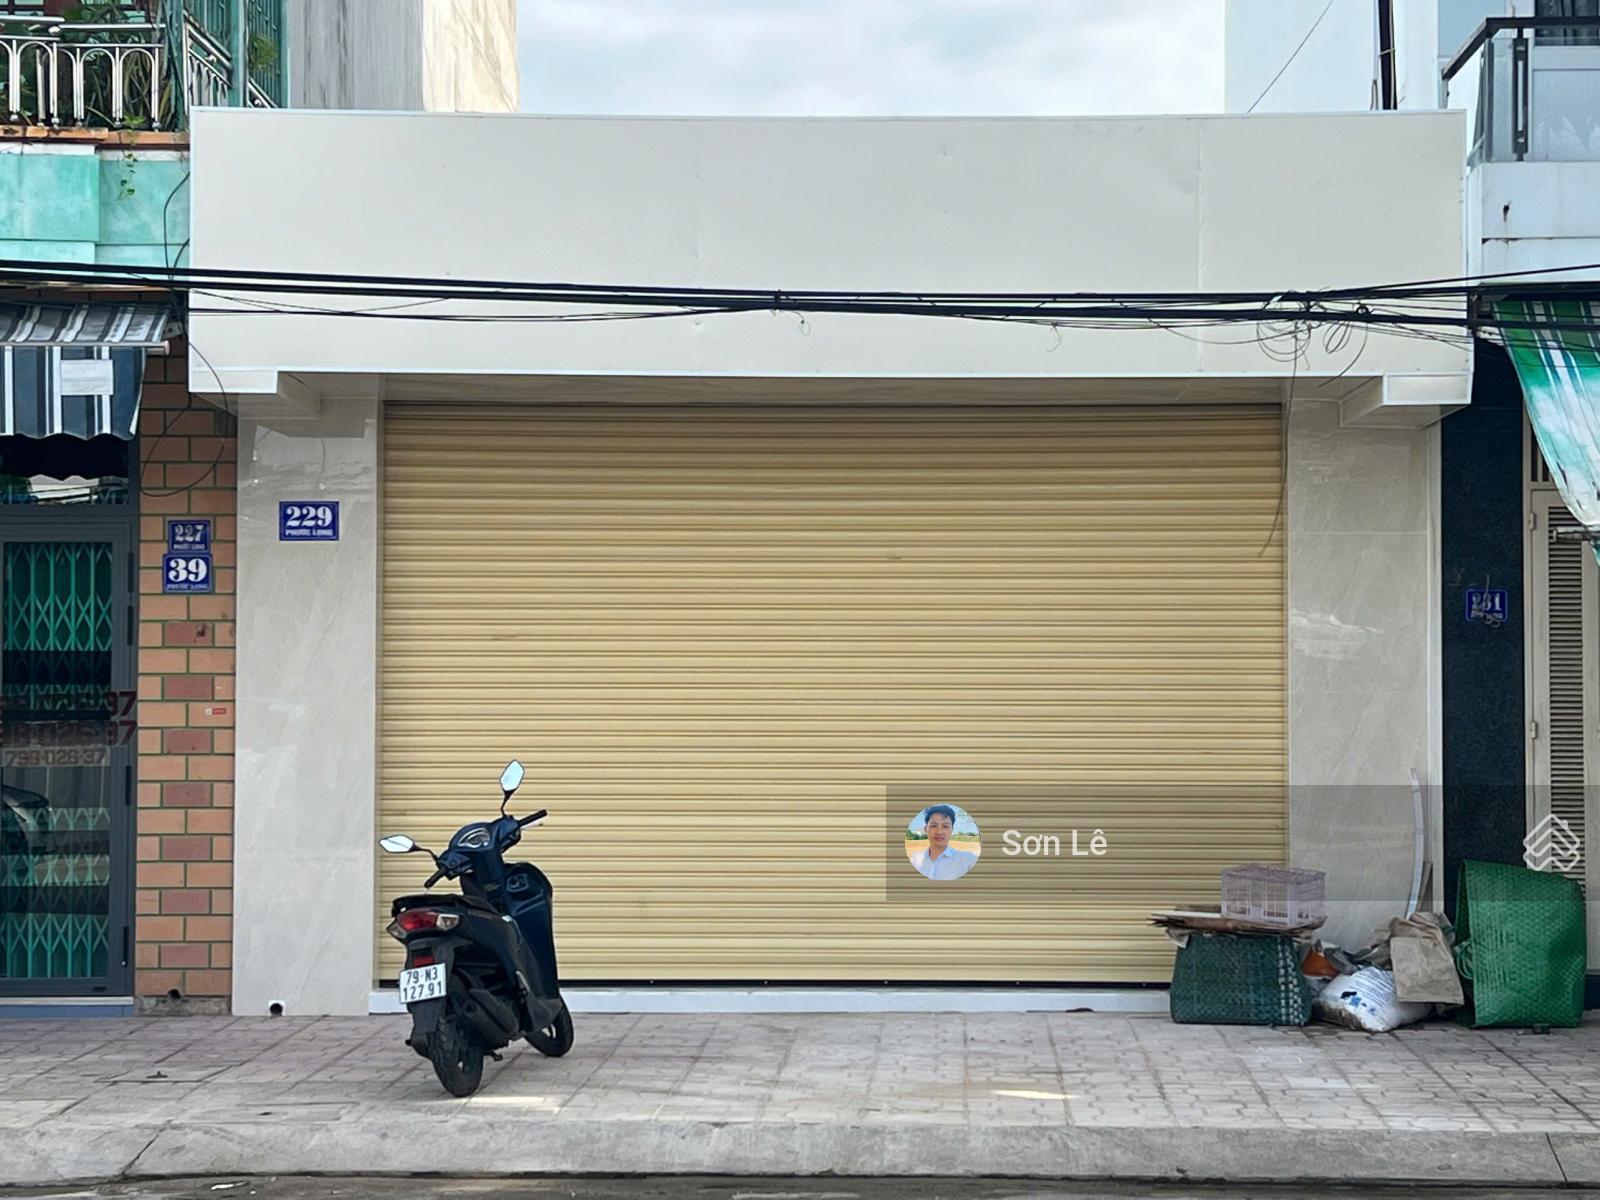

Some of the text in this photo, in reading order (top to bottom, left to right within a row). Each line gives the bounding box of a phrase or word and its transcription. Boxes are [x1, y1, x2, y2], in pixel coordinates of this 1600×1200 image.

[286, 506, 333, 527] 229
[175, 525, 204, 542] 227
[168, 558, 207, 582] 39
